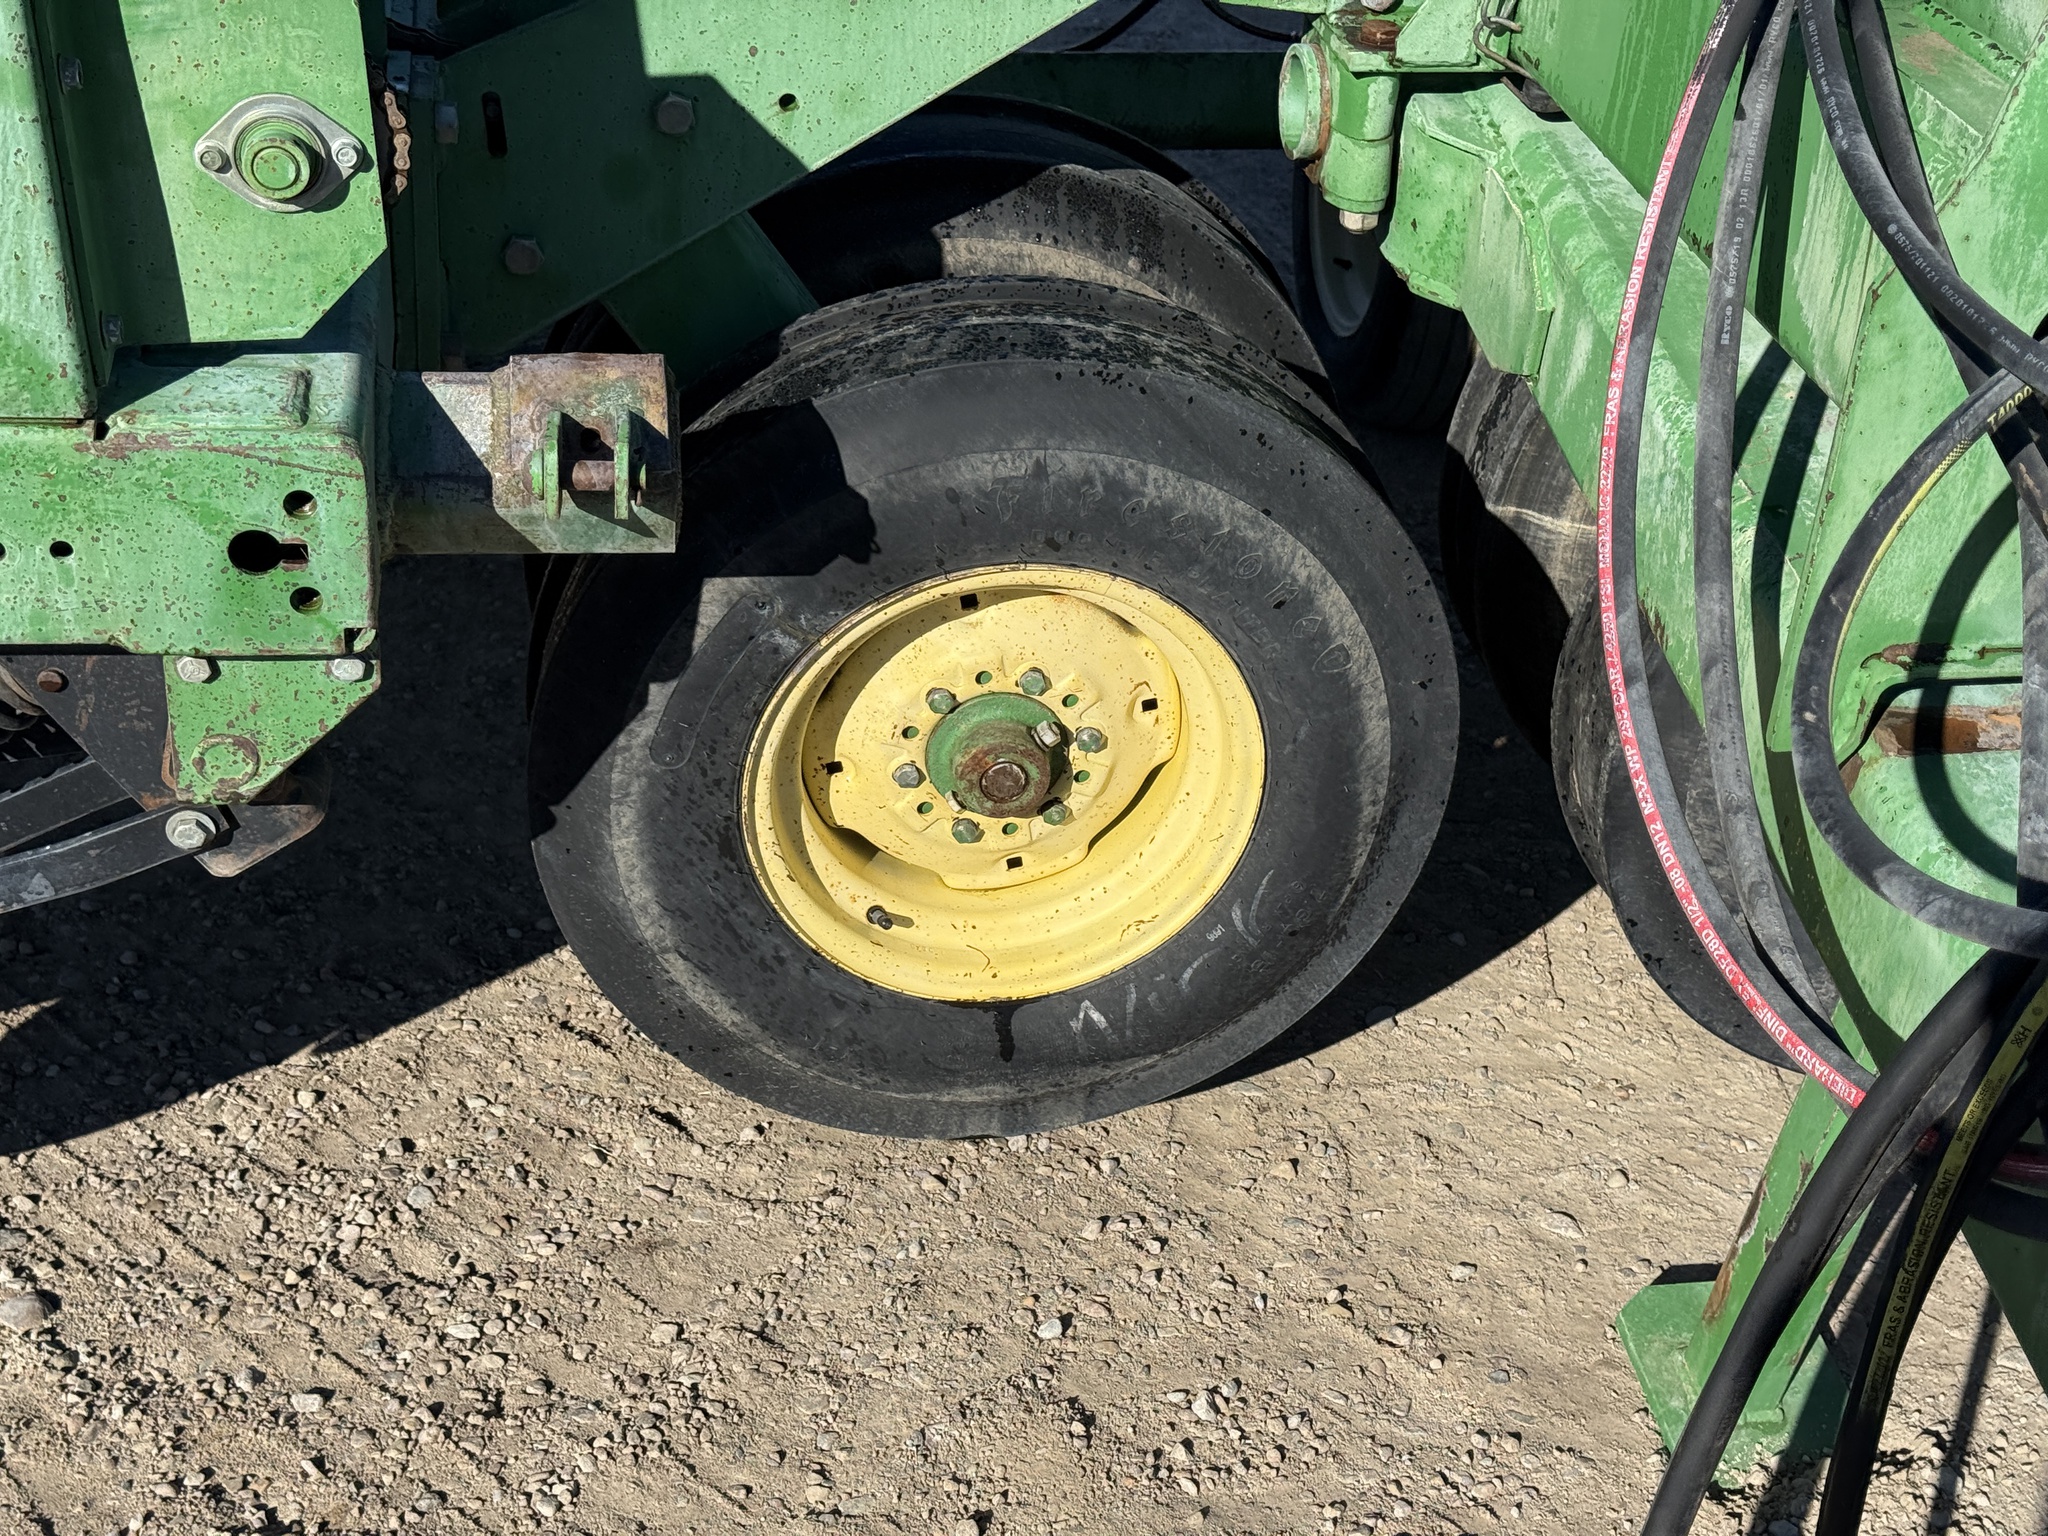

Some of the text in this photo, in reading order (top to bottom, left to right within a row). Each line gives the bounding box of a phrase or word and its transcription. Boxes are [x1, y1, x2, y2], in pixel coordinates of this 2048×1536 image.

[1634, 159, 1672, 261] RESISTANT
[1612, 265, 1643, 365] ABRASION
[1720, 305, 1733, 345] RYCO
[1603, 386, 1619, 436] FRAS
[1608, 665, 1625, 705] BAR
[1623, 743, 1641, 773] WP
[1632, 773, 1655, 815] MAX
[1648, 820, 1676, 867] DN12
[1700, 926, 1738, 980] DF28D
[1882, 1314, 1901, 1348] FRAS
